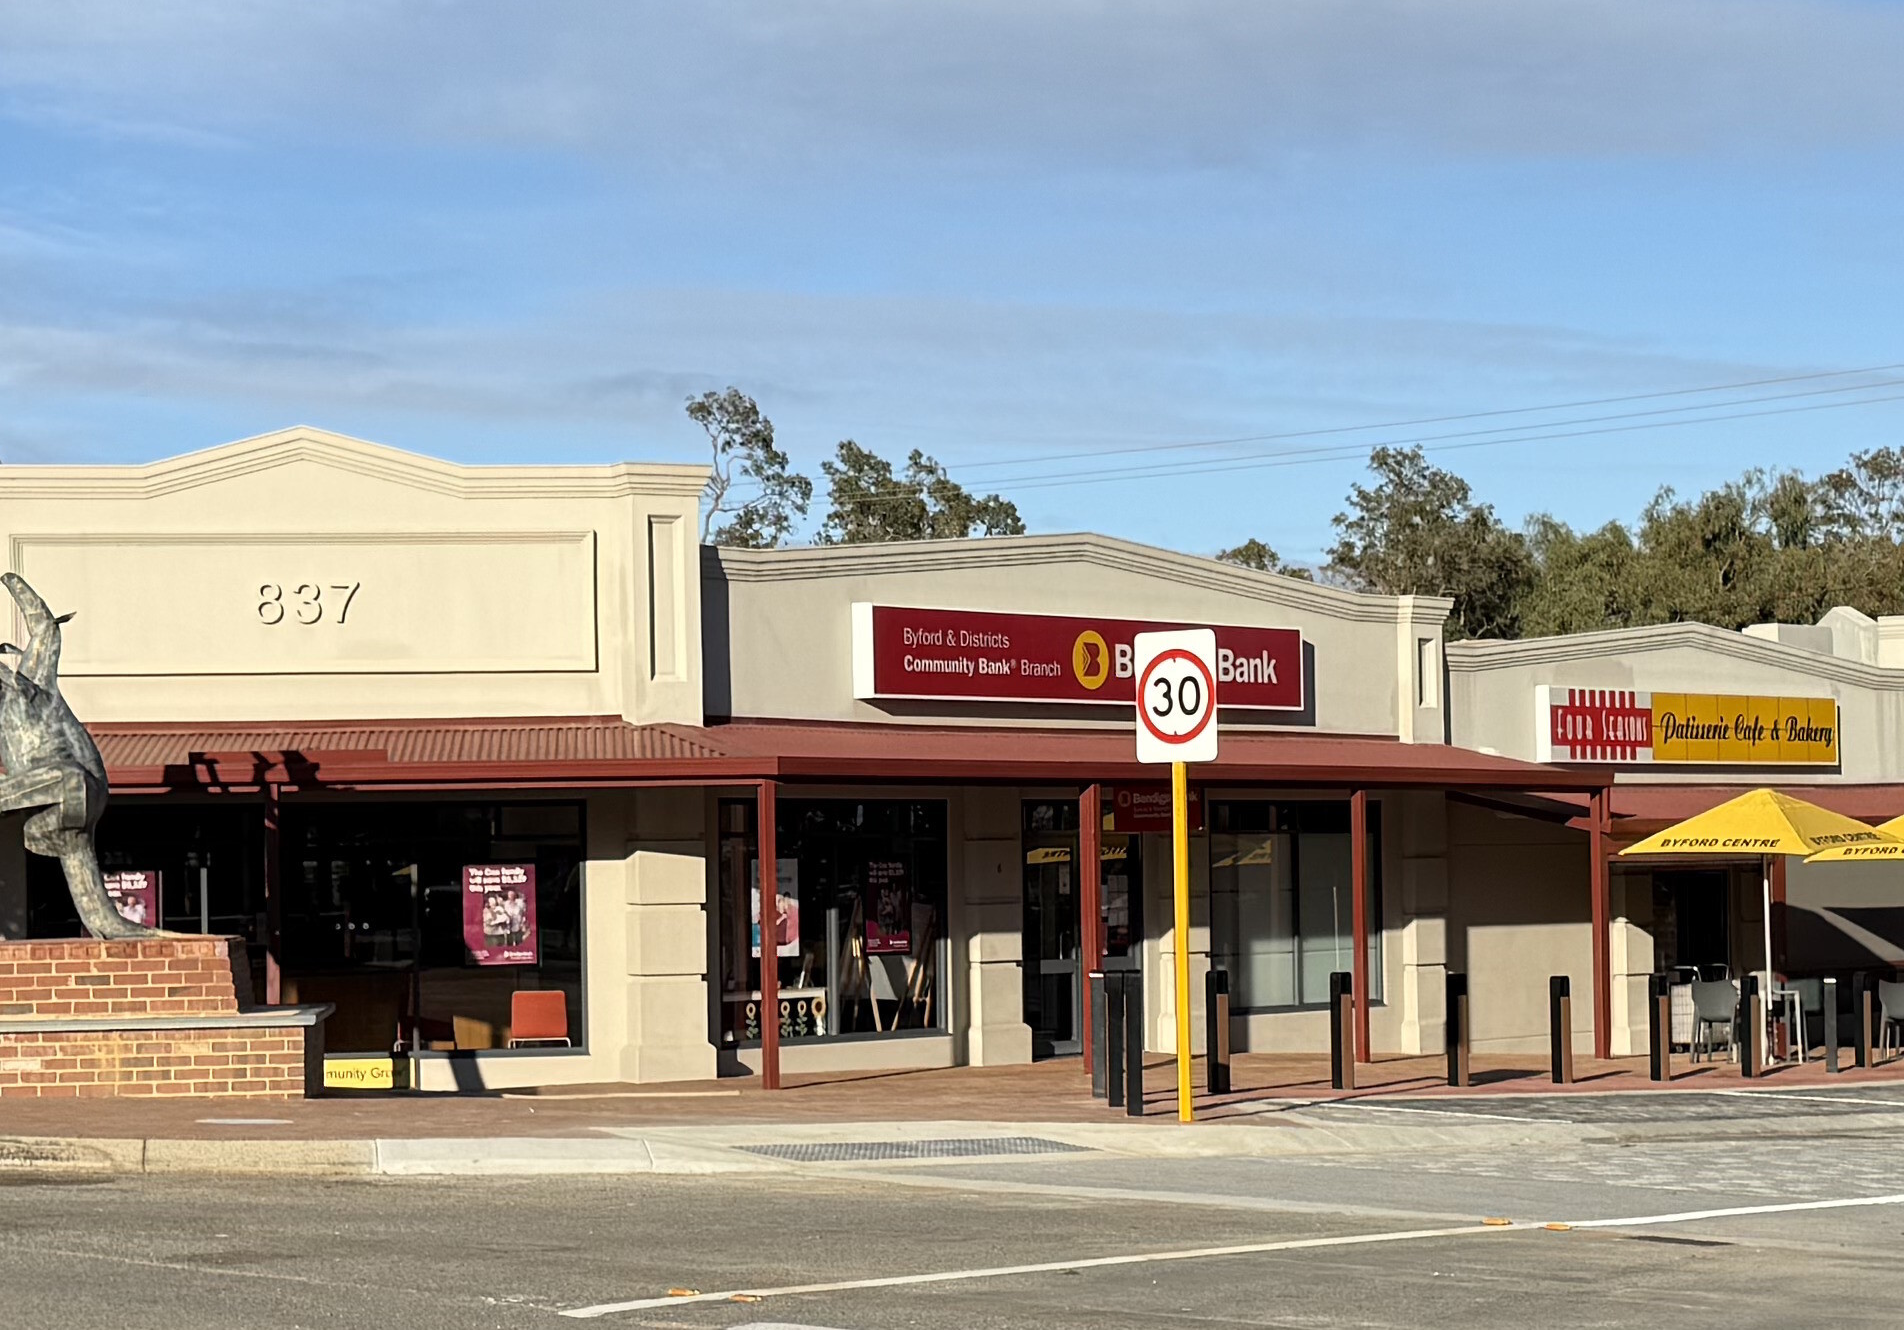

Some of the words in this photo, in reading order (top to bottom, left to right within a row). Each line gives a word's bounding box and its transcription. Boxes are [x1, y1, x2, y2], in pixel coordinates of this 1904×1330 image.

[258, 581, 360, 626] 837
[903, 627, 943, 649] Byford
[947, 630, 956, 647] &
[960, 630, 1010, 649] Districts
[904, 655, 975, 677] Community
[1020, 659, 1061, 677] Branch
[1217, 648, 1278, 684] Bank
[1152, 675, 1201, 717] 30
[1660, 712, 1730, 745] Patisserie
[1734, 713, 1765, 747] Cafe
[1770, 719, 1781, 741] &
[1786, 715, 1834, 748] Bakery
[1660, 838, 1718, 848] BYFORD
[1722, 838, 1781, 849] CENTRE
[1842, 846, 1899, 856] BYFORD
